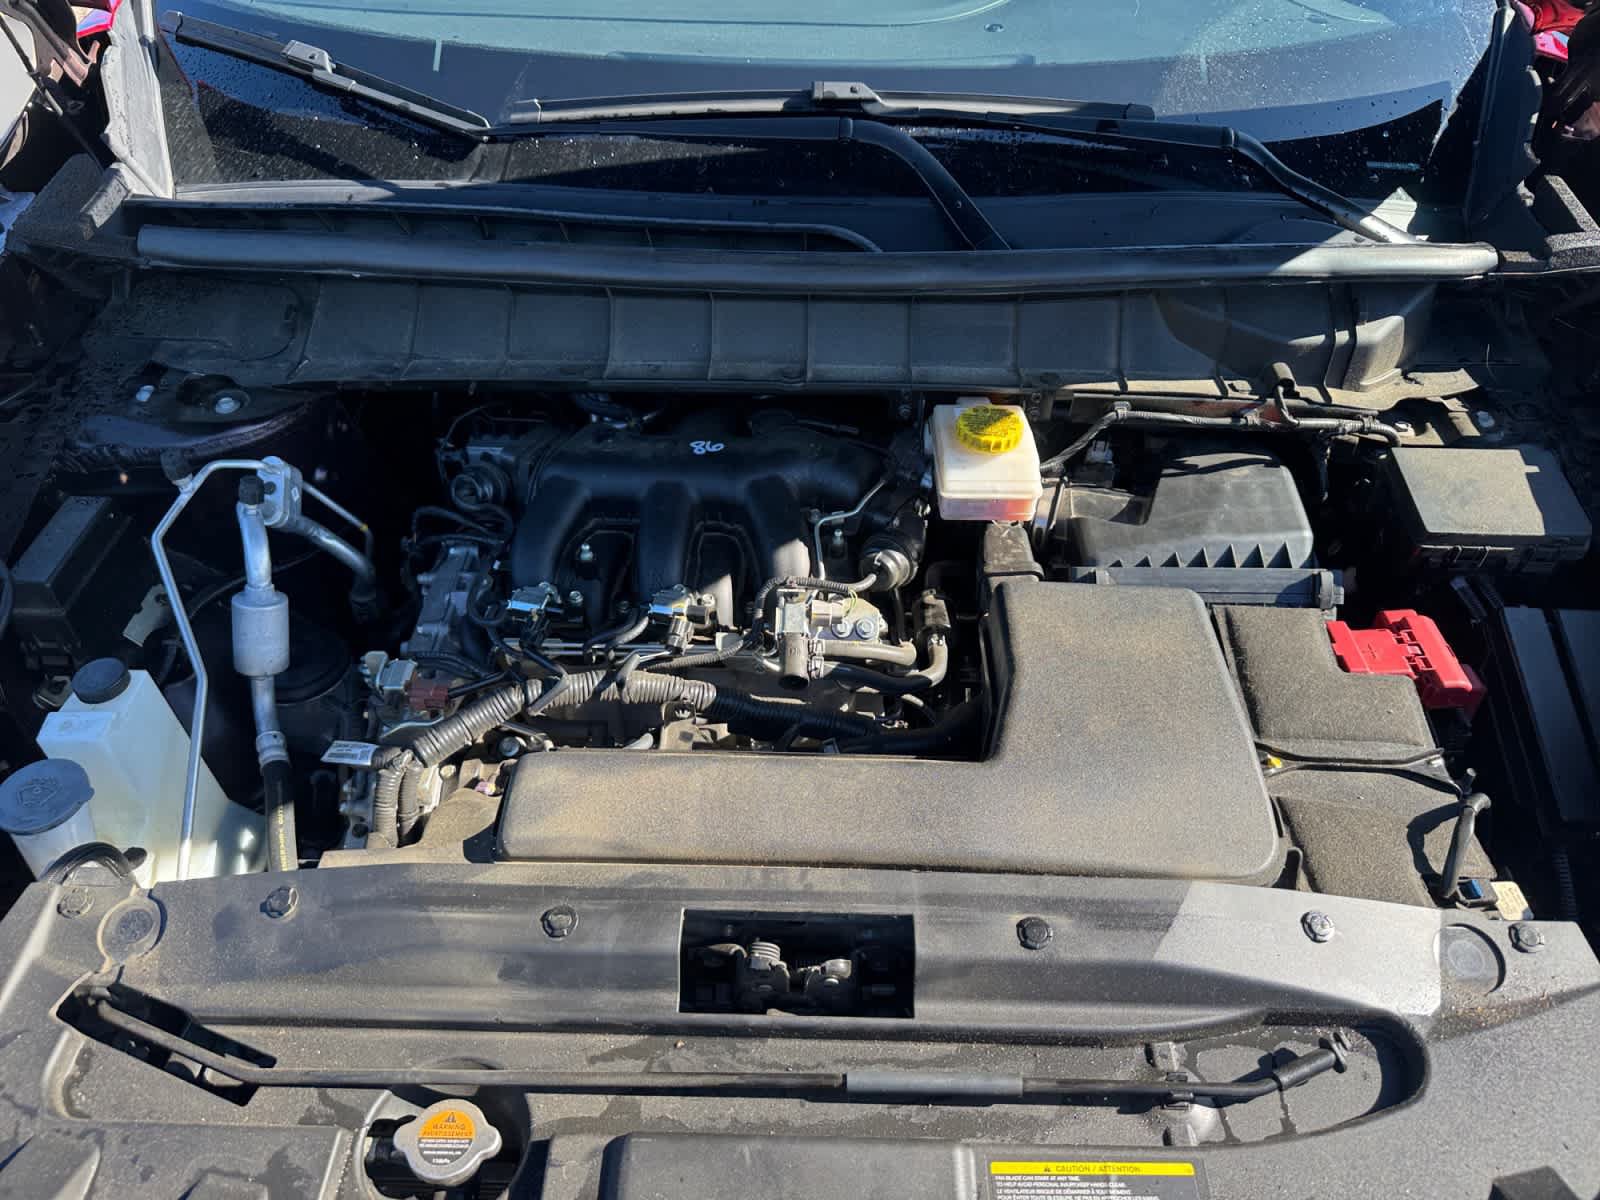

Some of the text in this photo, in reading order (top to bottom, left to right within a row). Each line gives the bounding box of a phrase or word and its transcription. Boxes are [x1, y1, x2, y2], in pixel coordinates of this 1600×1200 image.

[689, 440, 725, 455] 86
[1055, 1165, 1090, 1173] CAUTION
[1099, 1165, 1141, 1173] ATTENTION
